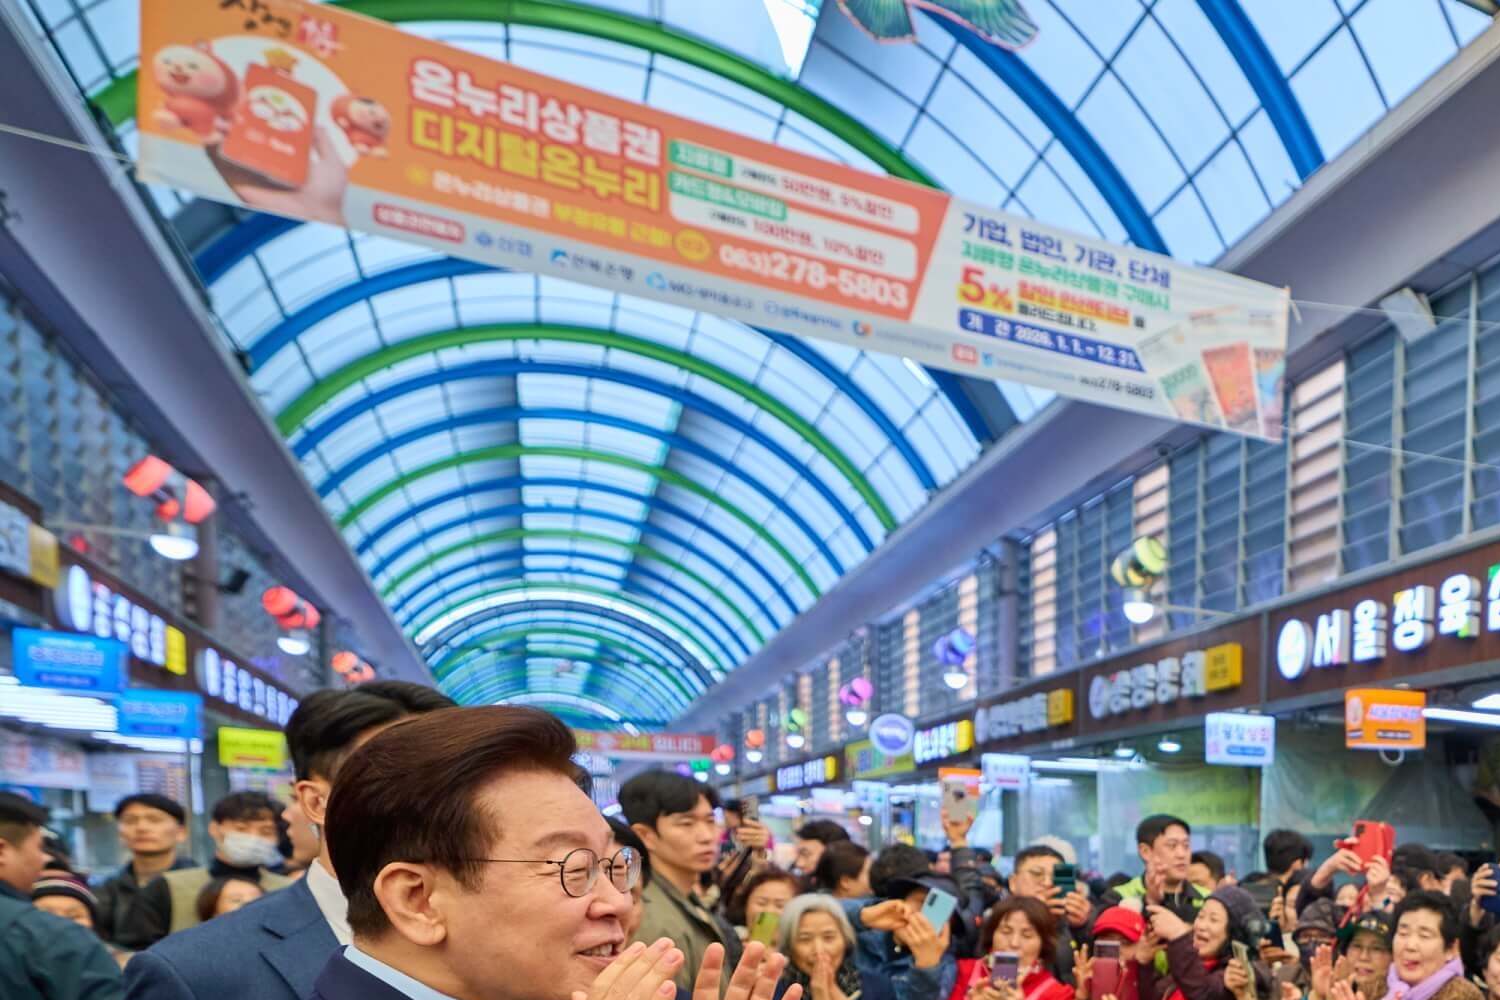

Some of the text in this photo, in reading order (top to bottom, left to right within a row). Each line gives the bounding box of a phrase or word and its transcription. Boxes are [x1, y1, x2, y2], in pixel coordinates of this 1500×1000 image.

[409, 58, 663, 167] 온누리상품권
[410, 109, 661, 211] 디지털온누리
[719, 244, 909, 309] 063)278-5803
[961, 212, 1172, 290] 기업, 법인, 기관, 단체
[1017, 254, 1120, 298] 온누리상품권
